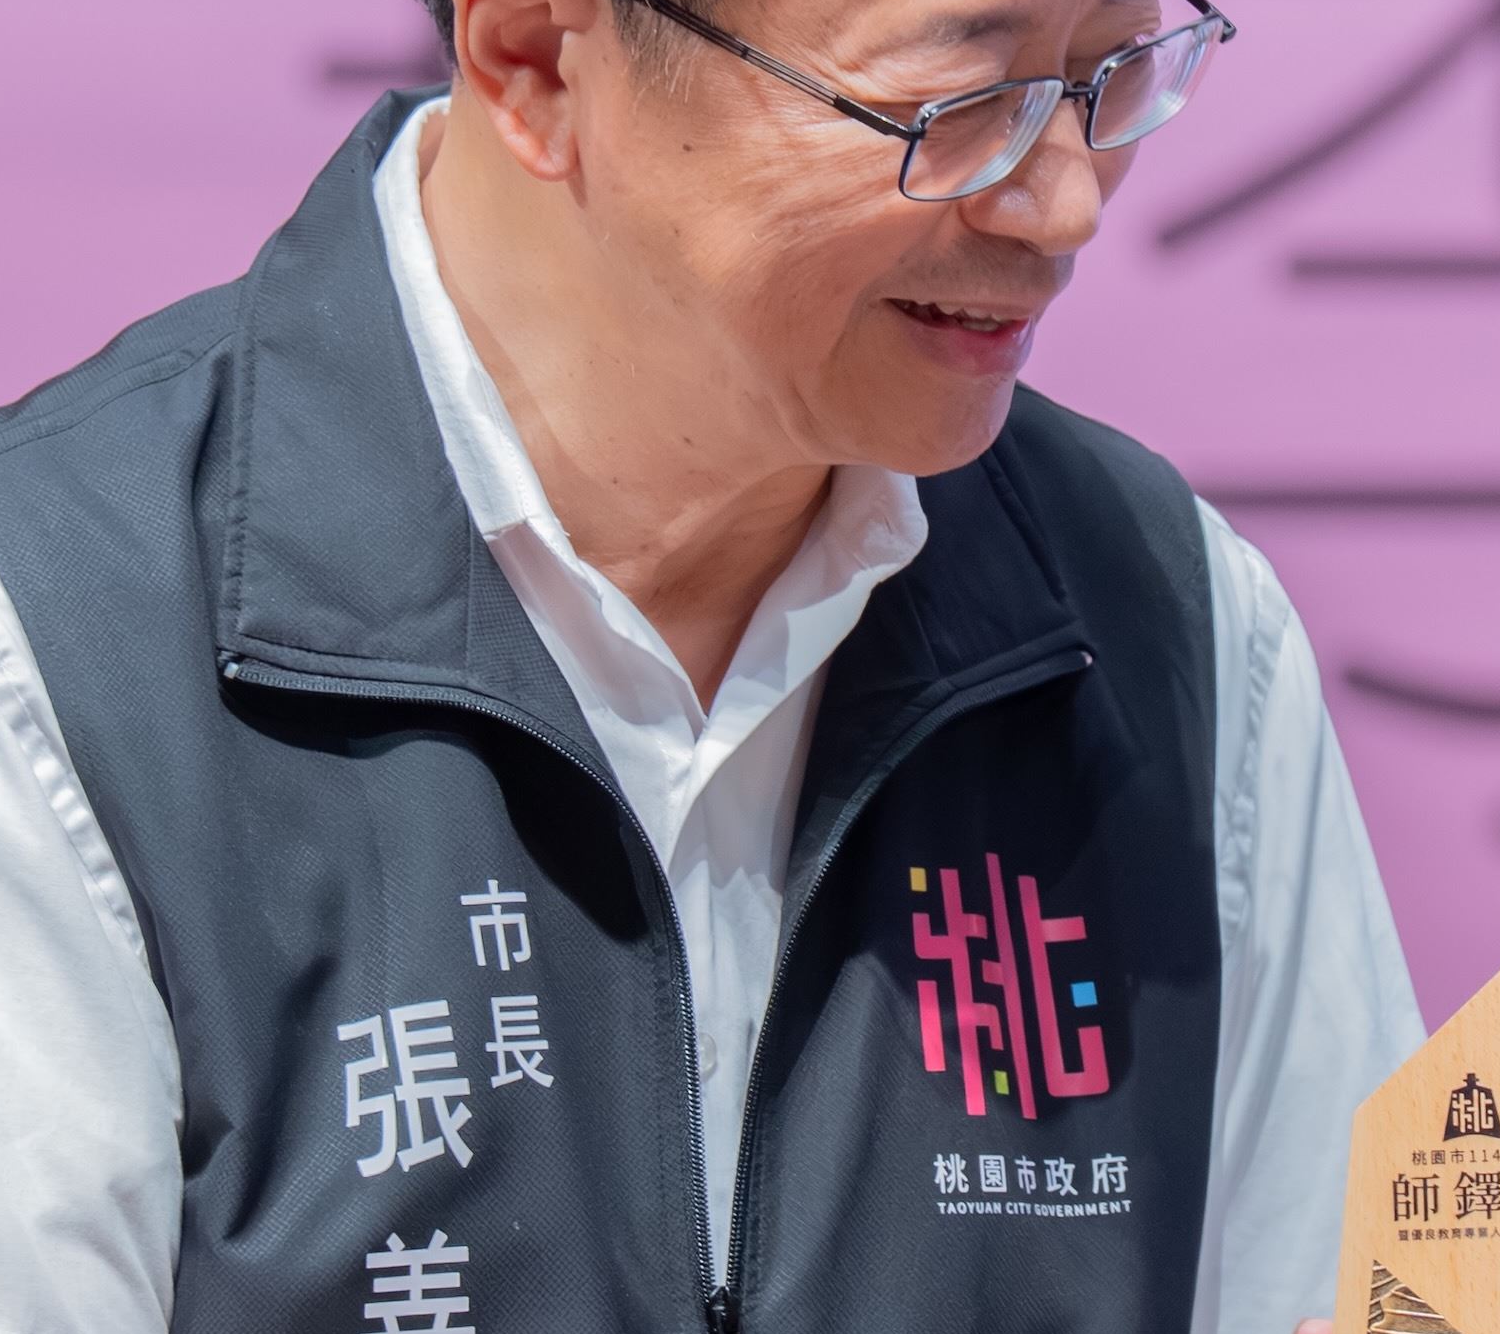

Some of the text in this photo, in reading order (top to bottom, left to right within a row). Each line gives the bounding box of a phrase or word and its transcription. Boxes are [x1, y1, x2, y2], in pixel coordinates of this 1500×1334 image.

[460, 880, 555, 1091] 市長
[933, 1153, 1129, 1197] 桃園市政府
[937, 1200, 1132, 1218] TAOYUAN CITY GOVERNMENT
